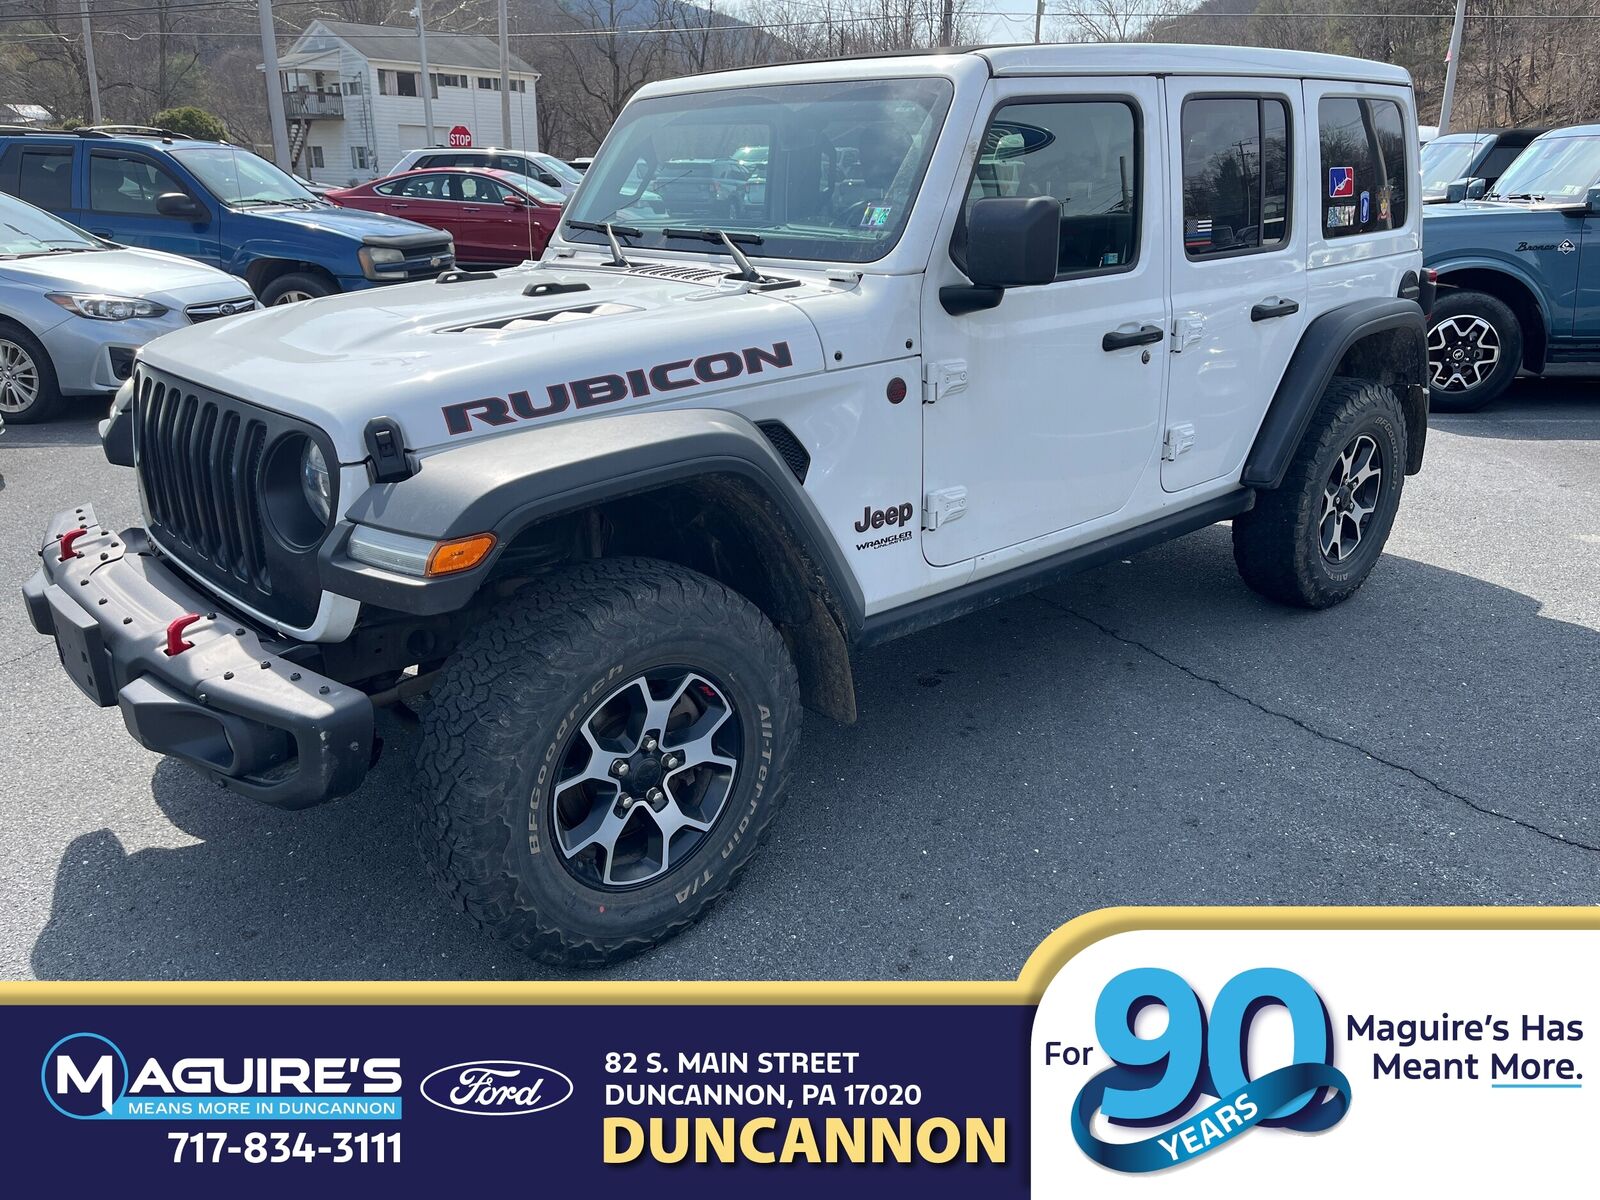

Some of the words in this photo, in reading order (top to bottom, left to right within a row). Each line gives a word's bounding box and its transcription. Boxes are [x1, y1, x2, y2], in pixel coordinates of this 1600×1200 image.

[450, 134, 471, 146] STOP
[1515, 241, 1557, 252] Bronco
[441, 341, 794, 436] RUBICON
[854, 502, 914, 533] Jeep
[856, 530, 912, 551] WRANGLER
[528, 664, 625, 855] BFGoodrich
[721, 703, 774, 860] All-Terrain
[675, 869, 714, 904] T/A
